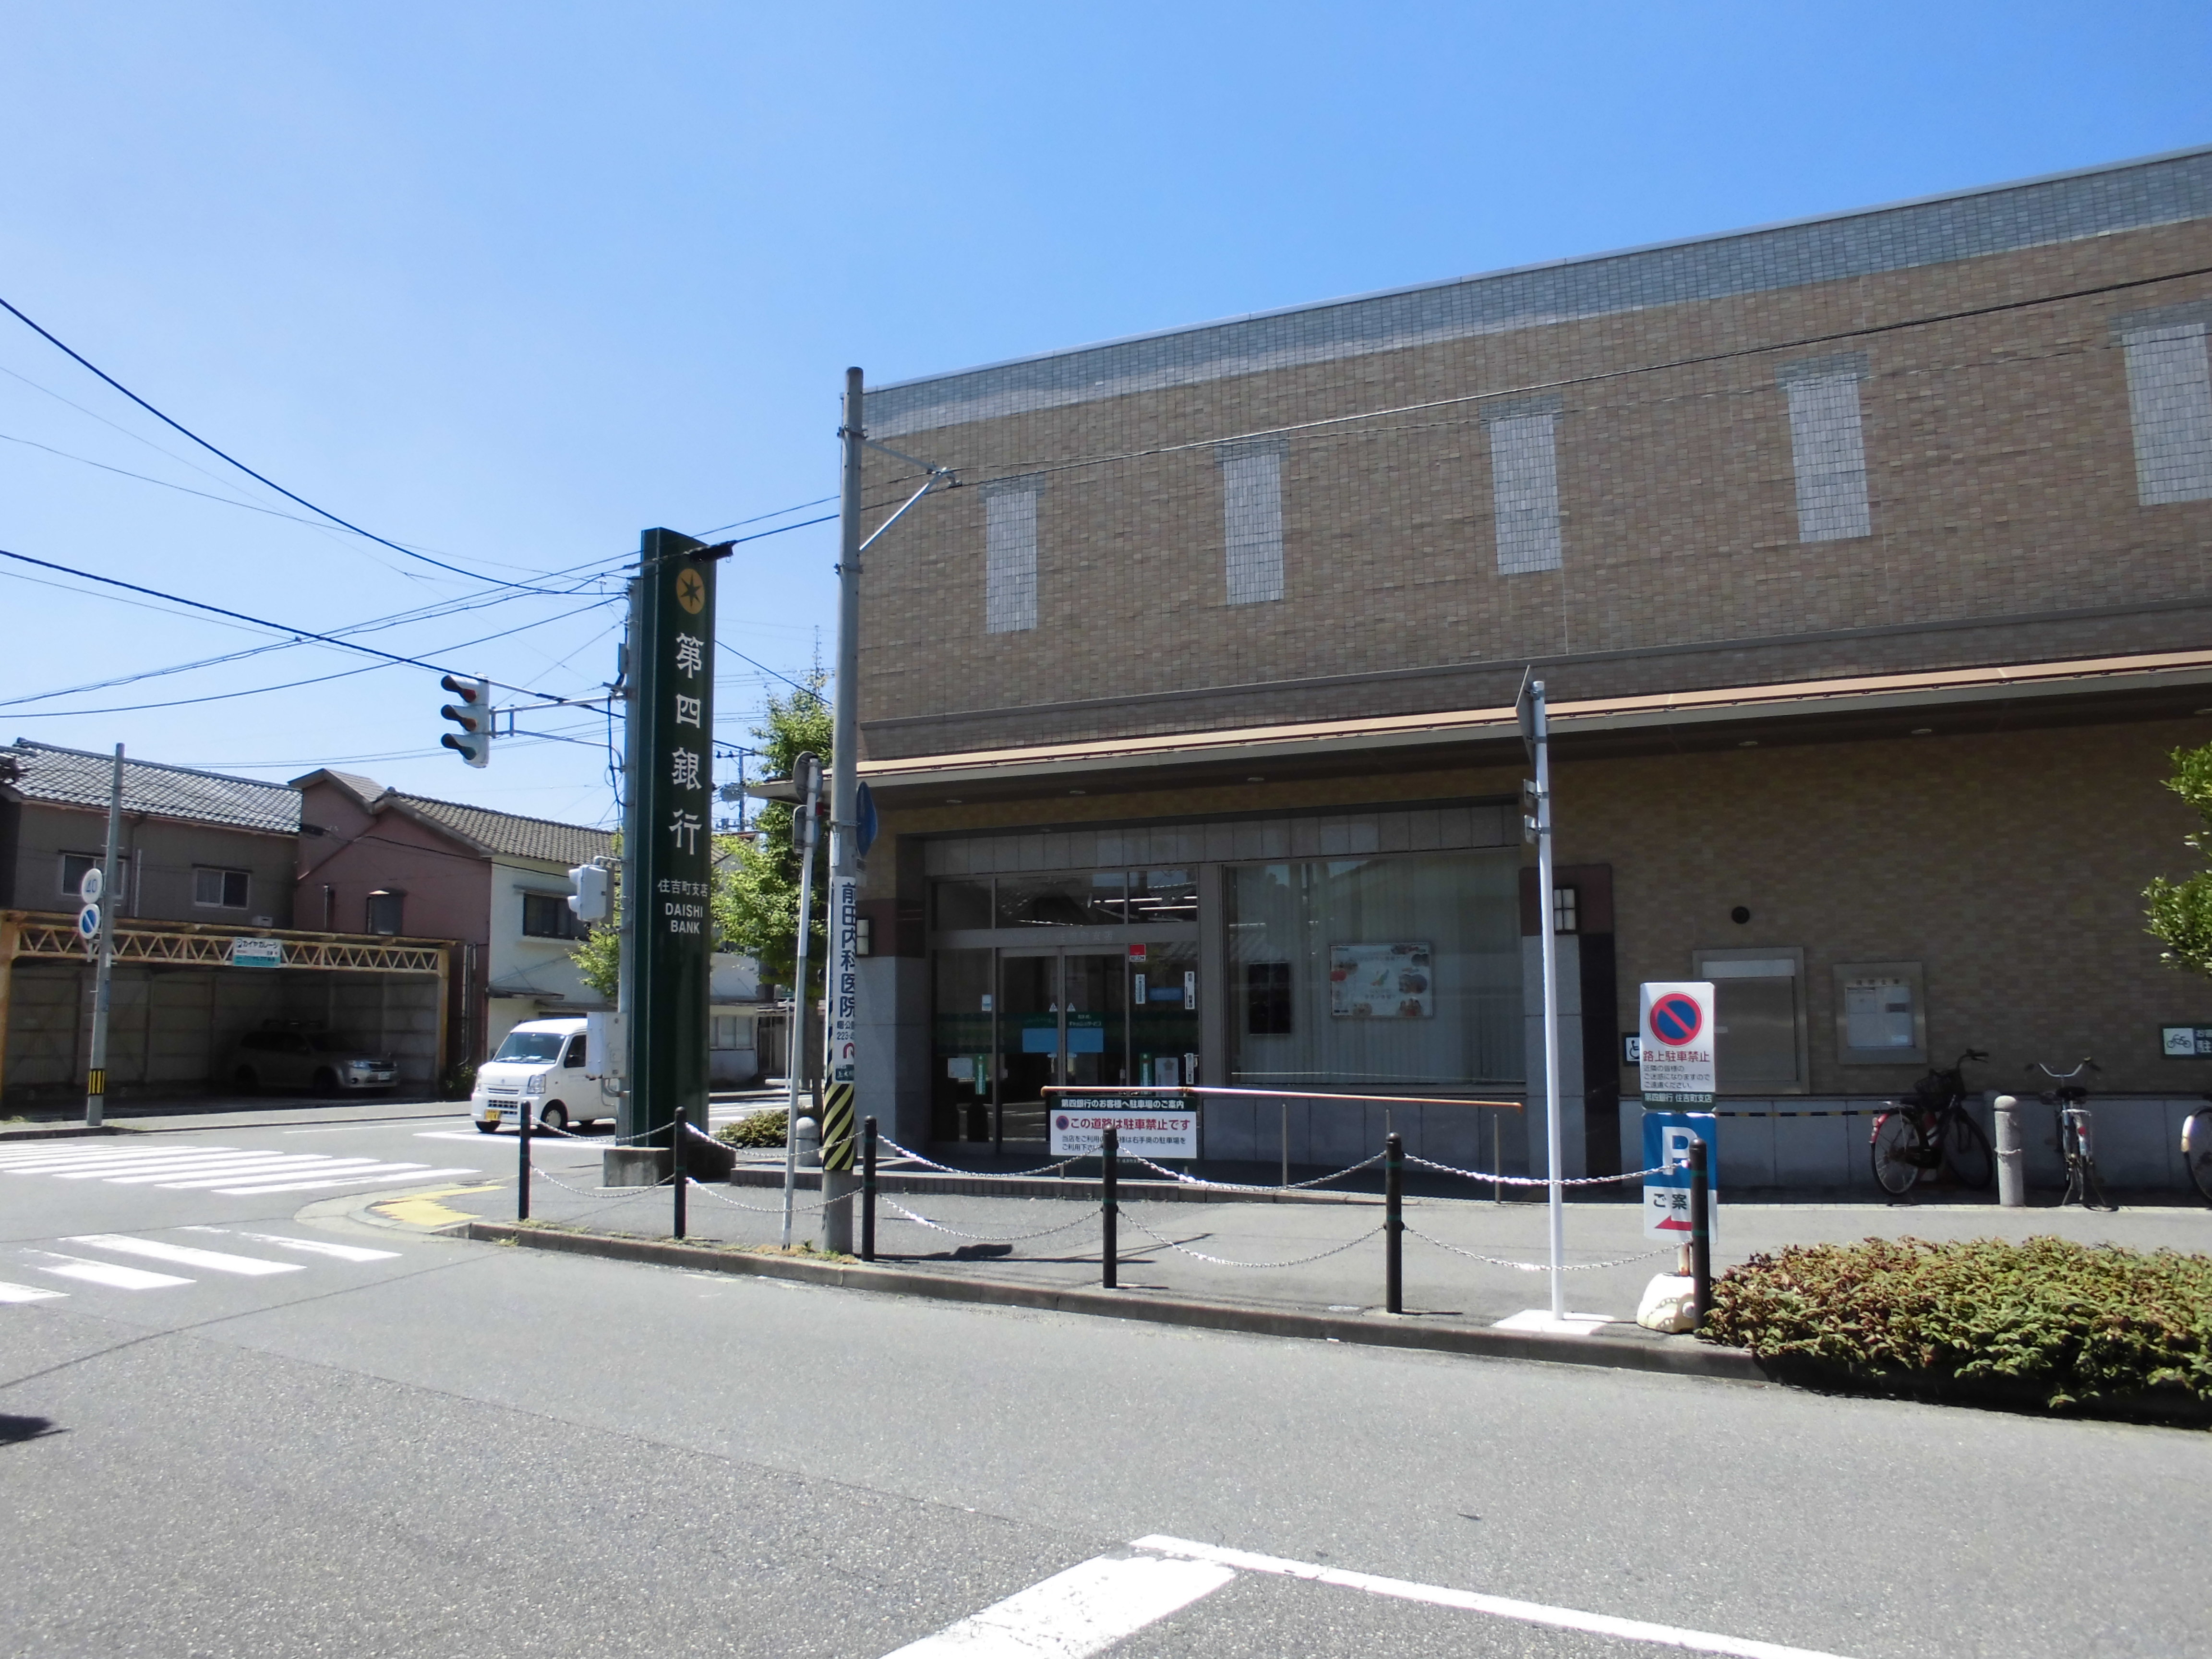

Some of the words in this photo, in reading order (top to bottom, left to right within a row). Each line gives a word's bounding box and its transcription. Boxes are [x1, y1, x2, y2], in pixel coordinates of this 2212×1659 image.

[669, 632, 705, 856] 第四銀行
[658, 879, 709, 897] 住吉町支店
[665, 902, 703, 918] DAISHI
[671, 919, 700, 934] BANK
[1643, 1051, 1710, 1063] 路上駐車禁止
[1061, 1099, 1184, 1109] 第四銀行のお客様へ駐車場のご案内
[1644, 1093, 1673, 1102] 第四銀行
[1675, 1094, 1712, 1103] 住吉町支店
[1071, 1118, 1190, 1130] この道路は駐車禁止です
[1062, 1135, 1186, 1145] 当店をご利用の様は右手奥の駐車場を
[1662, 1126, 1697, 1175] P
